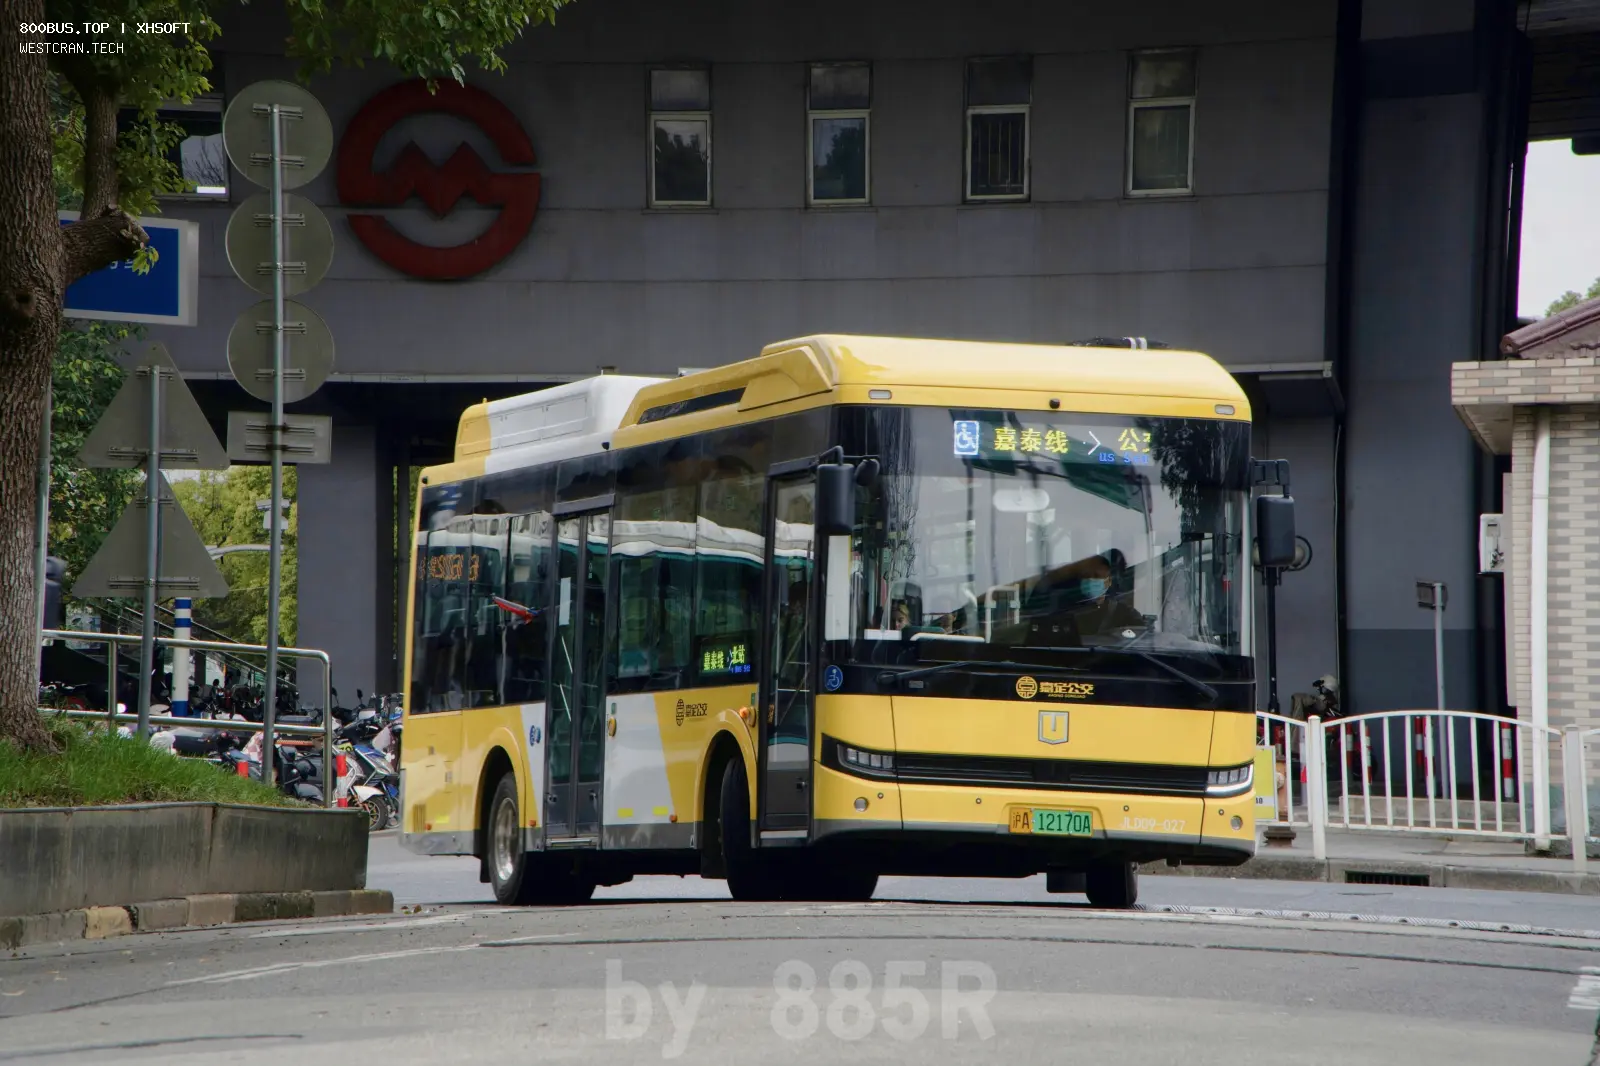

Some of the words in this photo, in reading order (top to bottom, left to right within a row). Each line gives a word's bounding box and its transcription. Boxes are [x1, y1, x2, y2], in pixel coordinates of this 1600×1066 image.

[994, 427, 1069, 454] 嘉泰线
[1039, 681, 1095, 695] 嘉定公交
[1038, 813, 1091, 833] 12170A
[1122, 816, 1186, 832] JLD09-027
